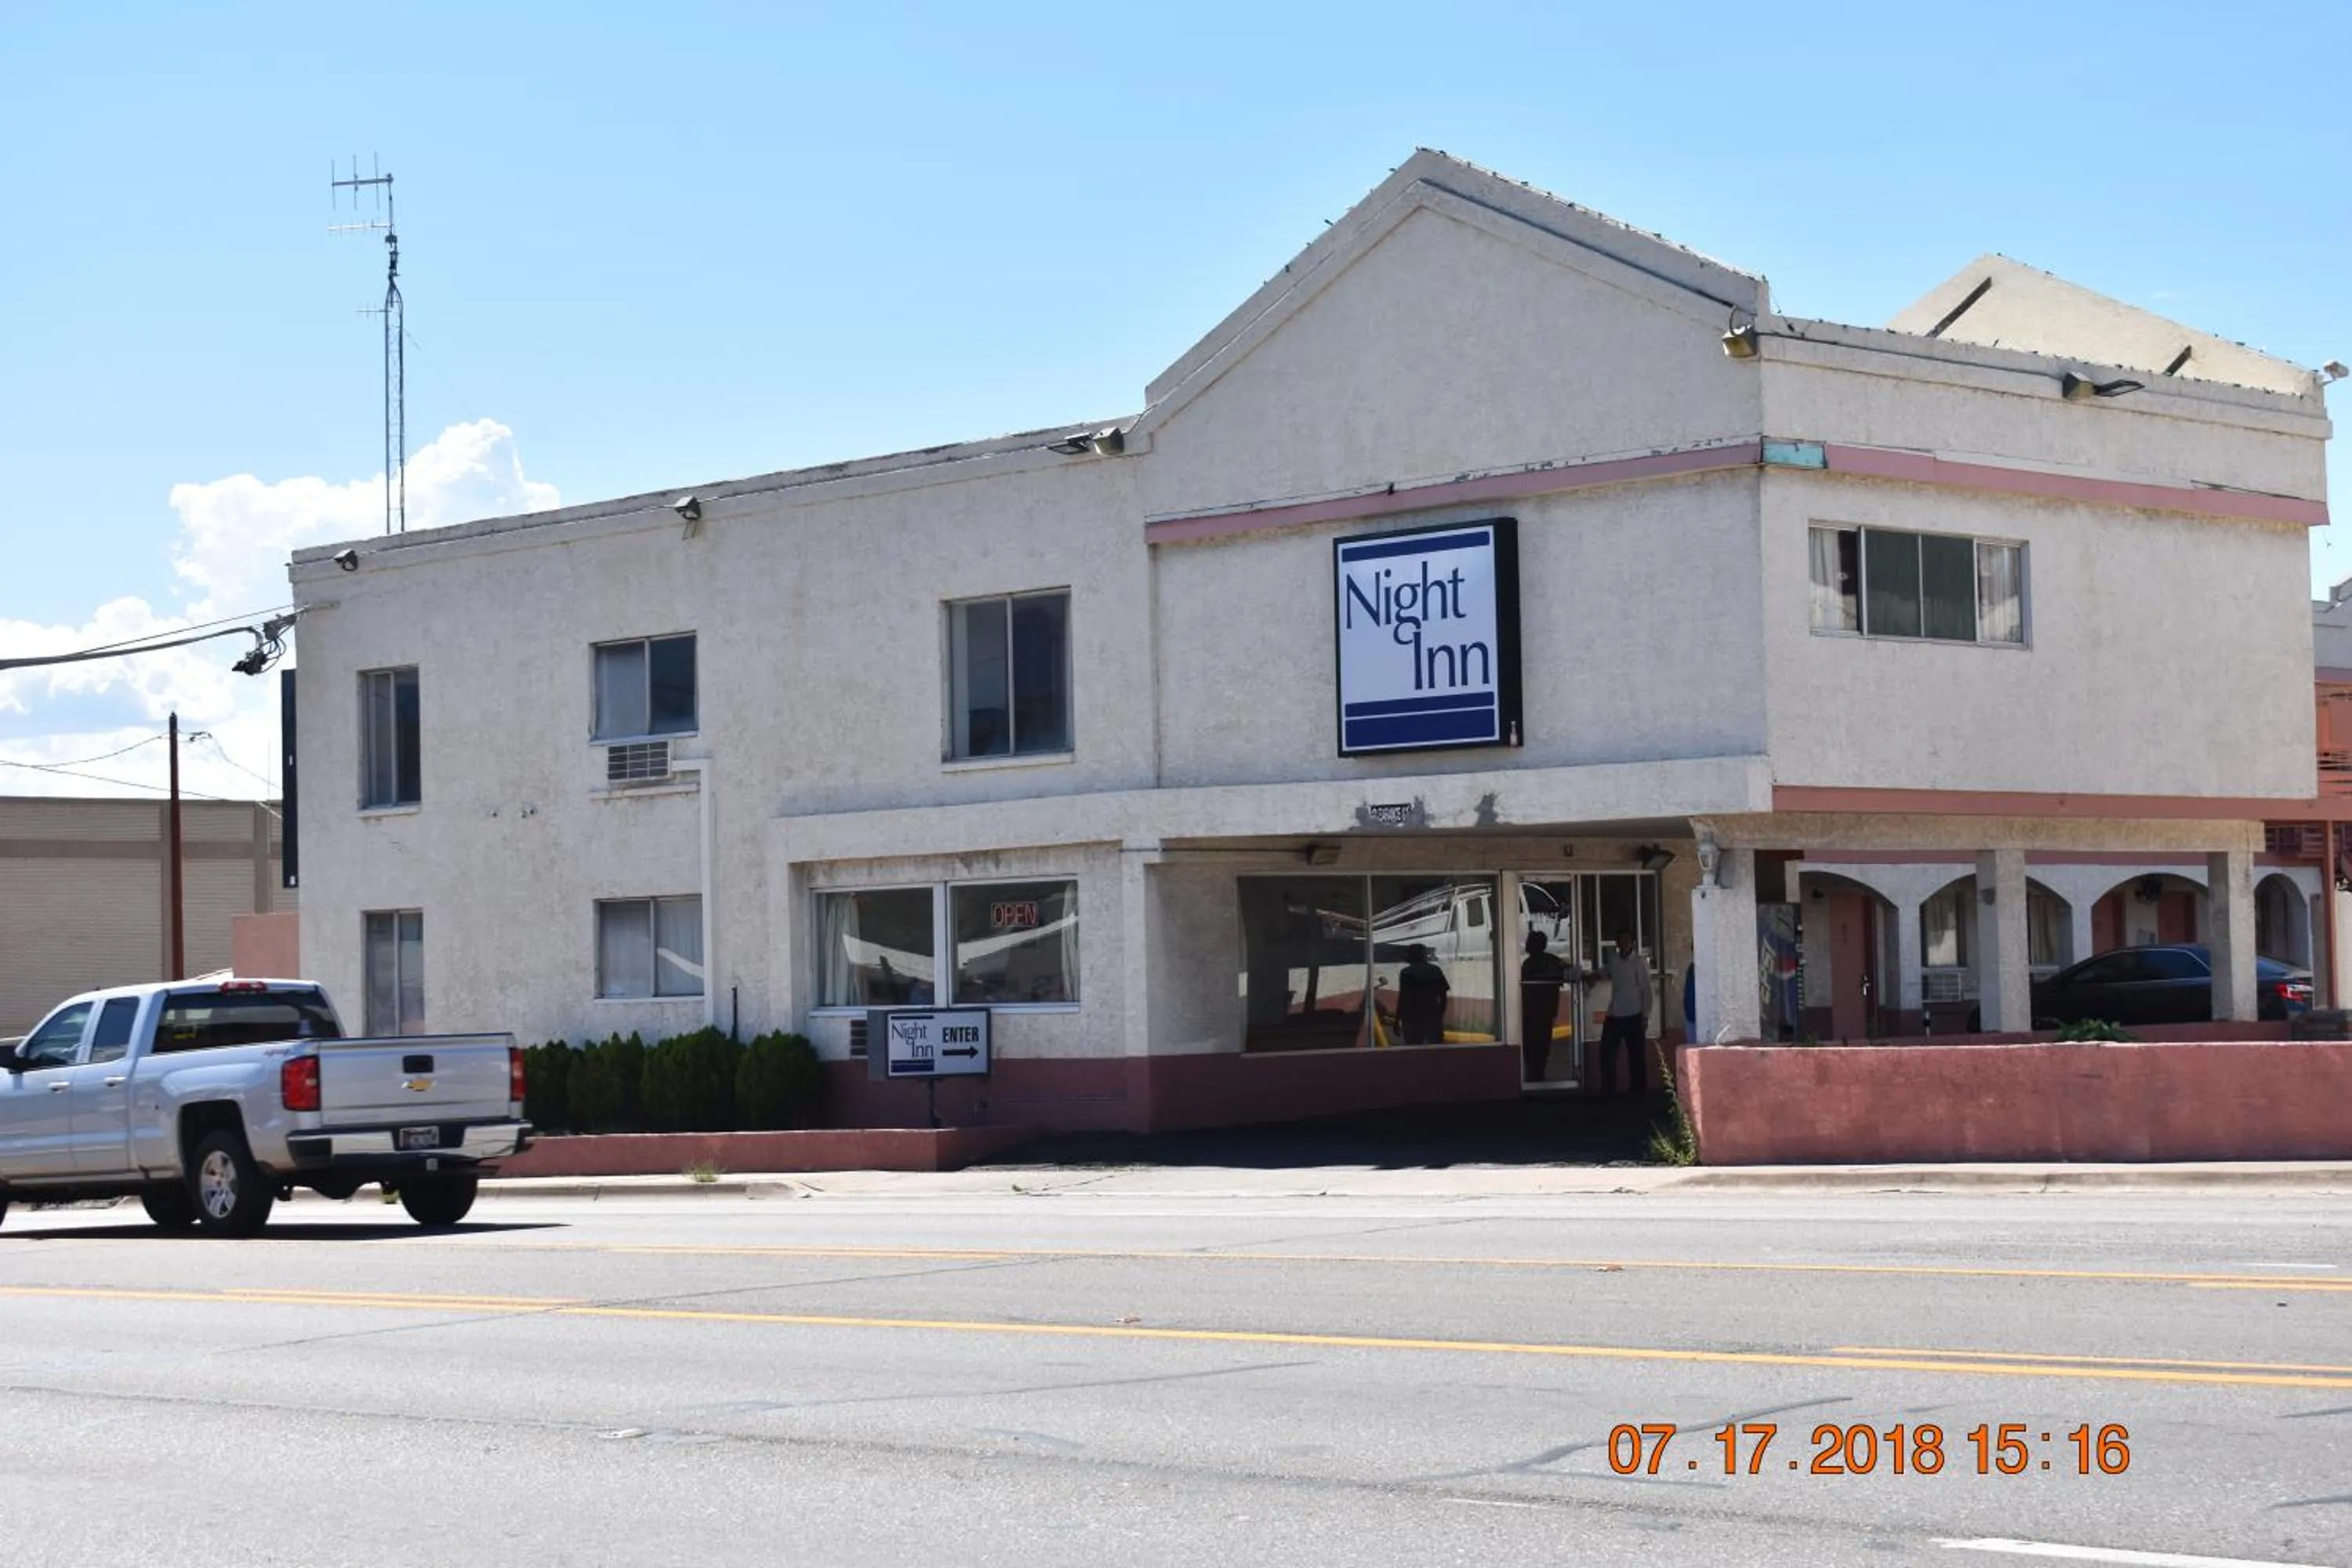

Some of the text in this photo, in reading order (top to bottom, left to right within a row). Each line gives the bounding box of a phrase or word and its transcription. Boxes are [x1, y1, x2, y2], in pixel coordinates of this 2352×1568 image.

[1346, 561, 1468, 645] Night
[1413, 630, 1490, 691] Inn
[993, 904, 1036, 926] OPEN
[891, 1022, 928, 1045] Night
[942, 1025, 979, 1044] ENTER
[911, 1039, 935, 1058] Inn
